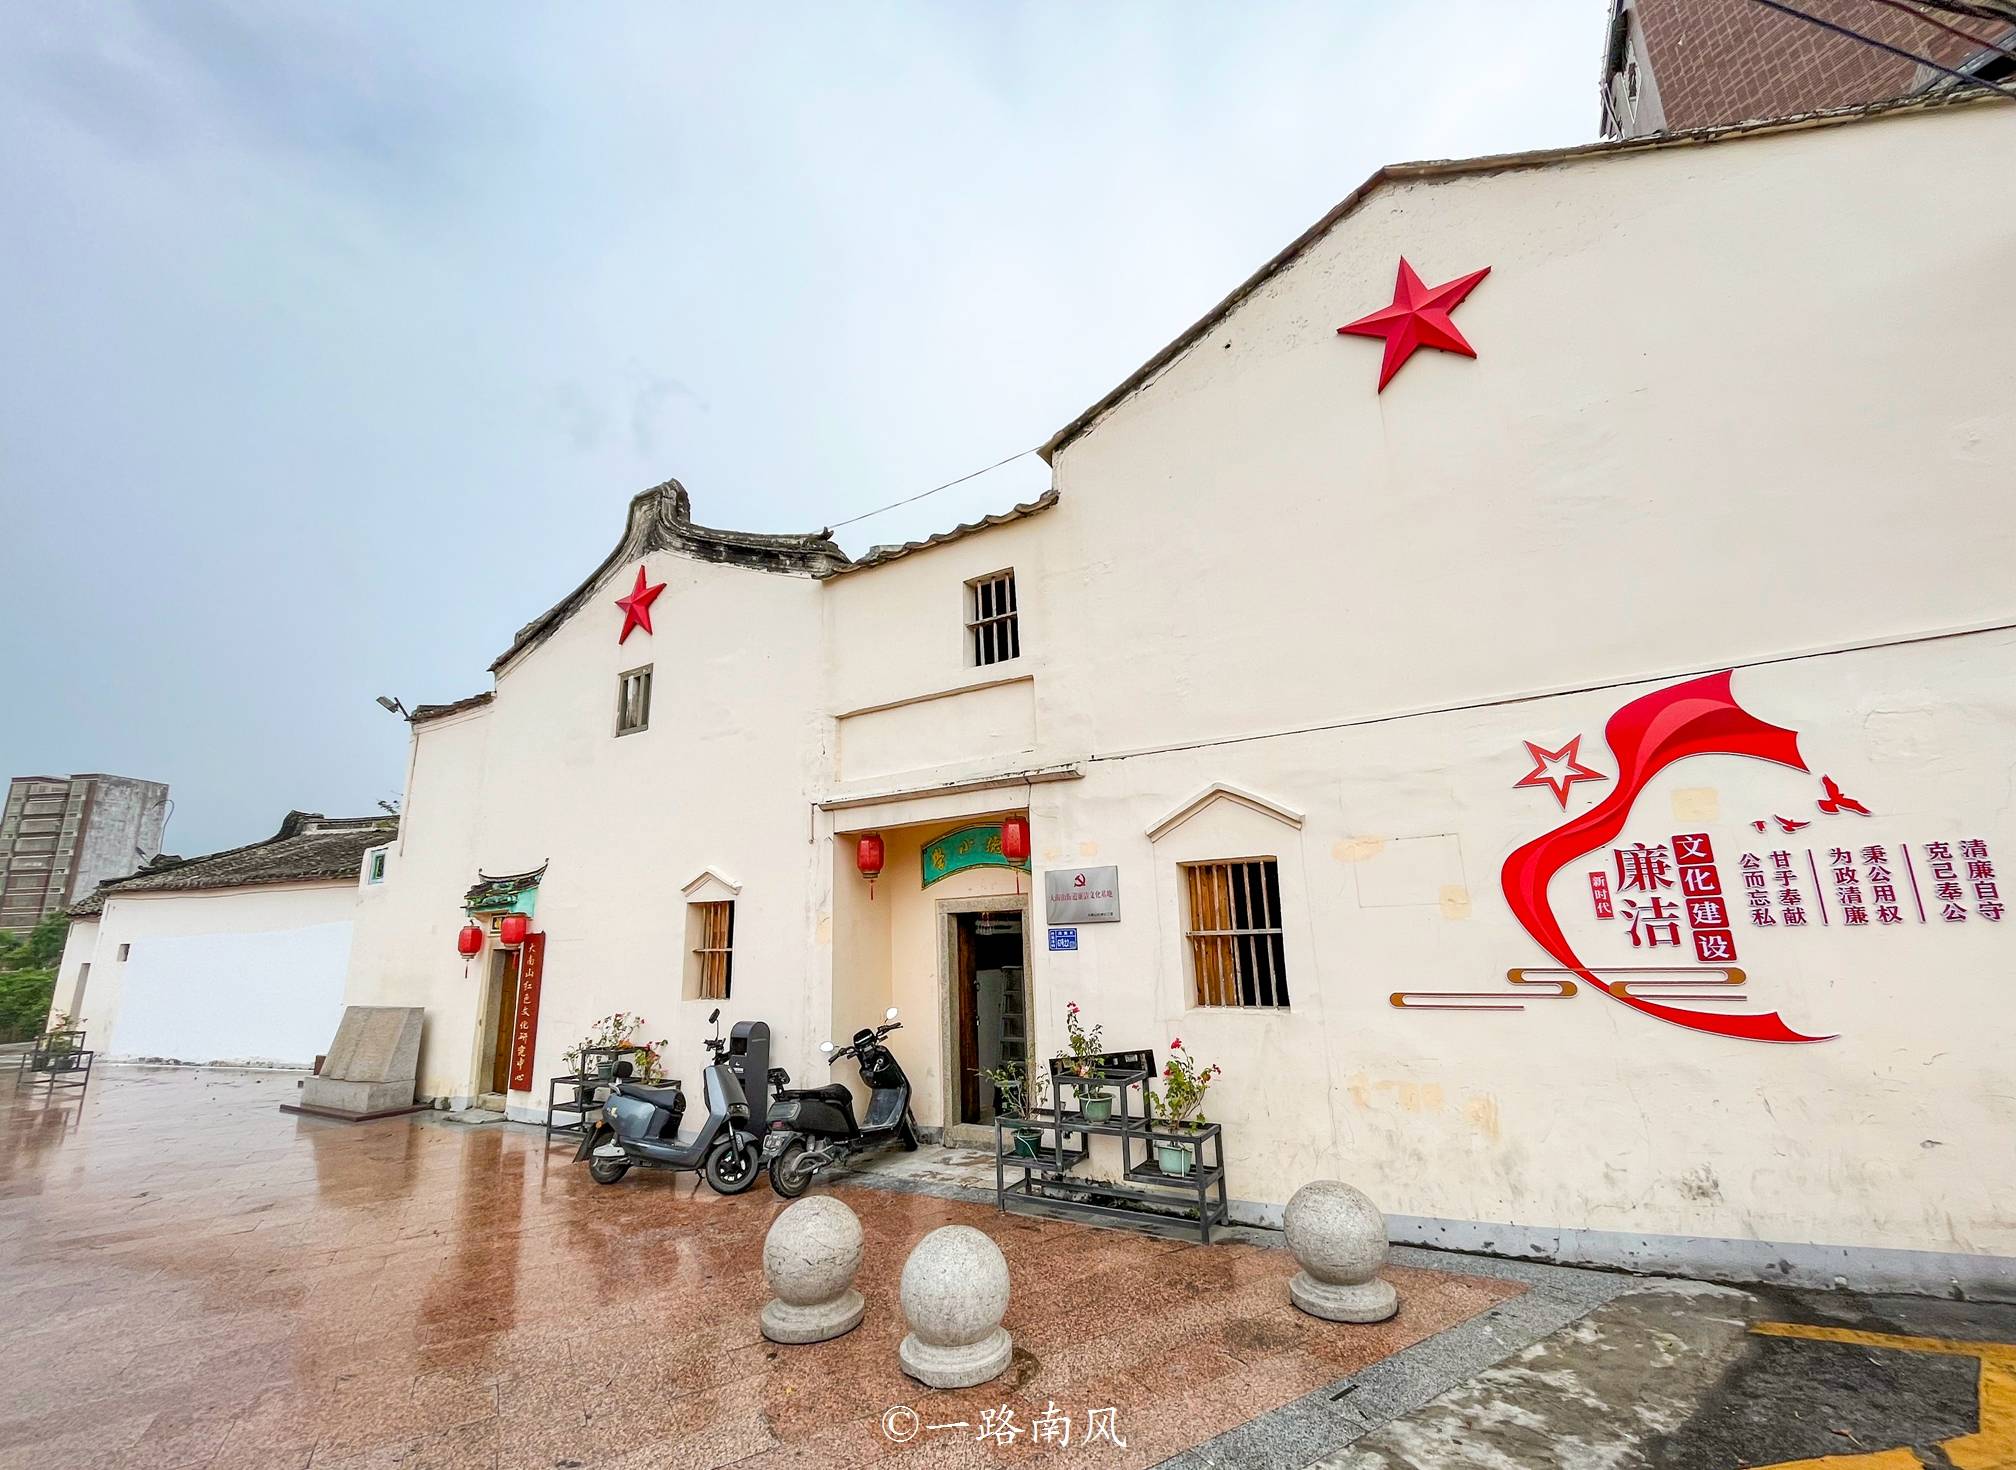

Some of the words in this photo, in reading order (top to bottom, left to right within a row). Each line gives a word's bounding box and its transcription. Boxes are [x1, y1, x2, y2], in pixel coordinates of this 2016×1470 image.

[1592, 876, 1611, 913] 新时代
[1613, 842, 1682, 947] 廉洁
[1676, 836, 1730, 959] 文化建设
[1739, 852, 1777, 927] 公而忘私
[1770, 851, 1807, 926] 甘于奉献
[1831, 847, 1869, 924] 为政清廉
[1863, 844, 1902, 923] 秉公用权
[1926, 841, 1967, 922] 克己奉公
[1960, 838, 2005, 920] 清廉自守
